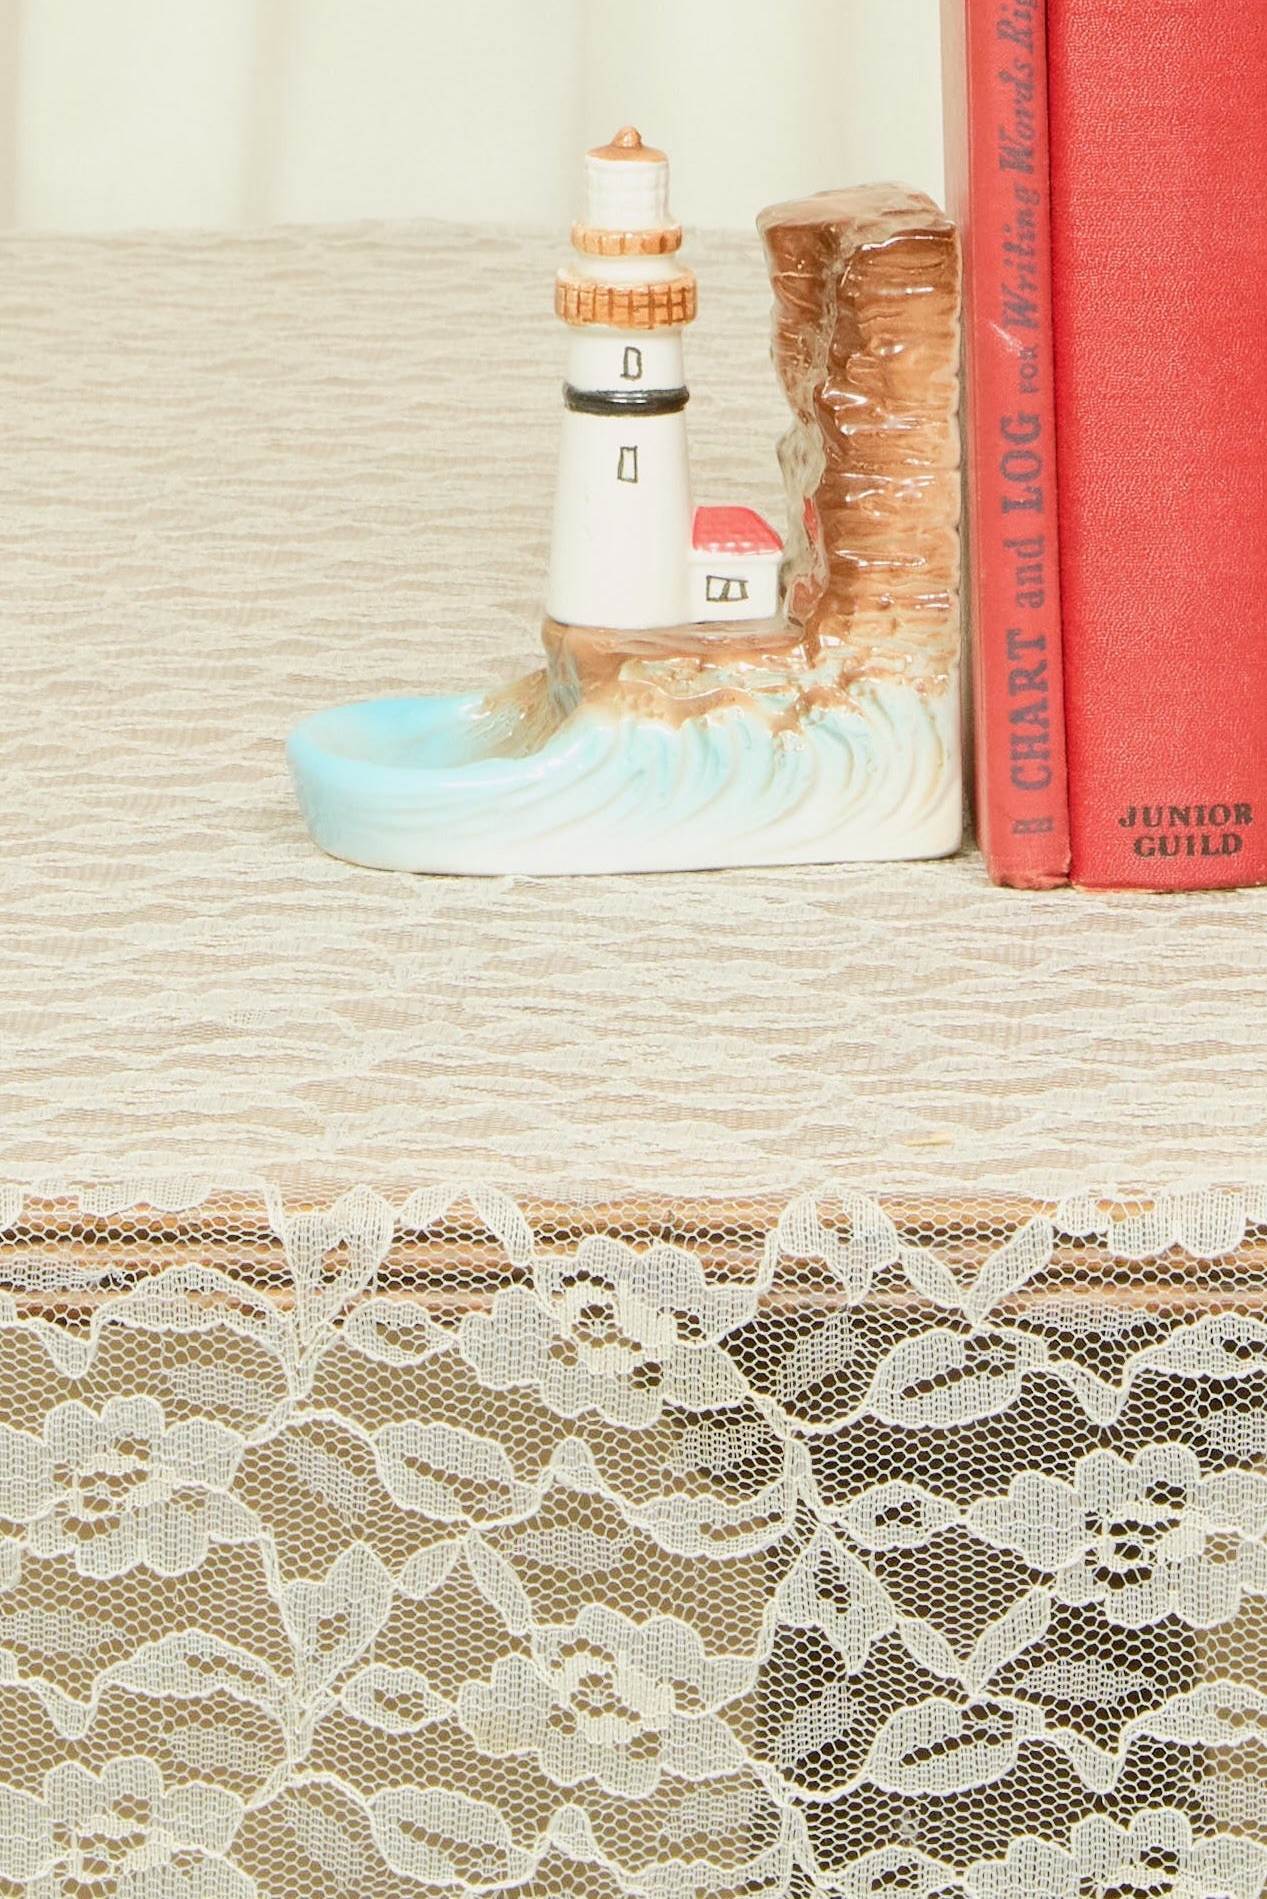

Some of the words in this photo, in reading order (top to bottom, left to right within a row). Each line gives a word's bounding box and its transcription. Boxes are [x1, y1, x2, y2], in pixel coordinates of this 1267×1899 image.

[998, 57, 1036, 175] Words
[1001, 182, 1041, 330] Writing
[1019, 345, 1039, 395] FOR
[1000, 412, 1044, 515] LOG
[1002, 534, 1046, 610] and
[1005, 627, 1053, 792] CHART
[1117, 803, 1254, 829] JUNIOR
[1132, 832, 1243, 858] GUILD
